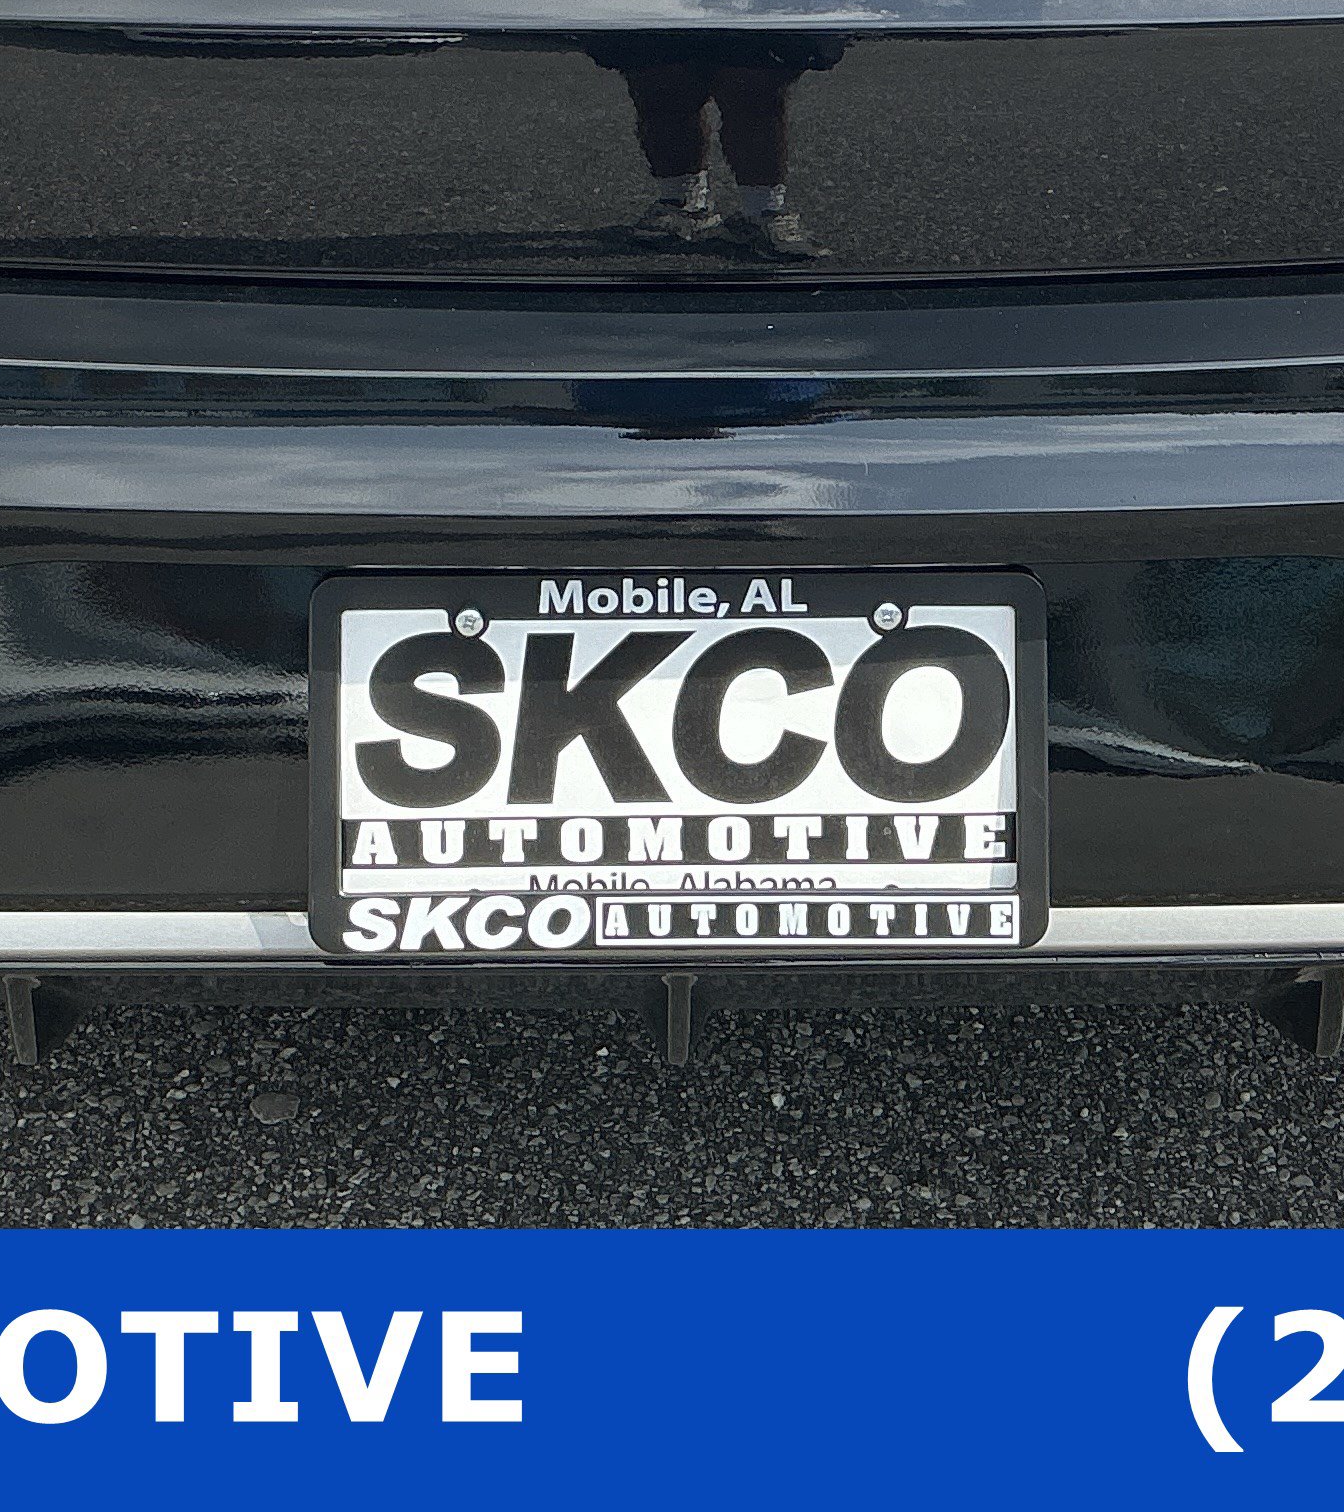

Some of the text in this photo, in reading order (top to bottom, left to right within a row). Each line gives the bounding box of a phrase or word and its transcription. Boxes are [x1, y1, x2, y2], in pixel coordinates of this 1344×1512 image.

[538, 577, 807, 618] Mobile, AL
[355, 625, 1010, 809] SKCO
[351, 816, 1007, 865] AUTOMOTIVE
[342, 894, 1013, 952] SKCO AUTOMOTIVE
